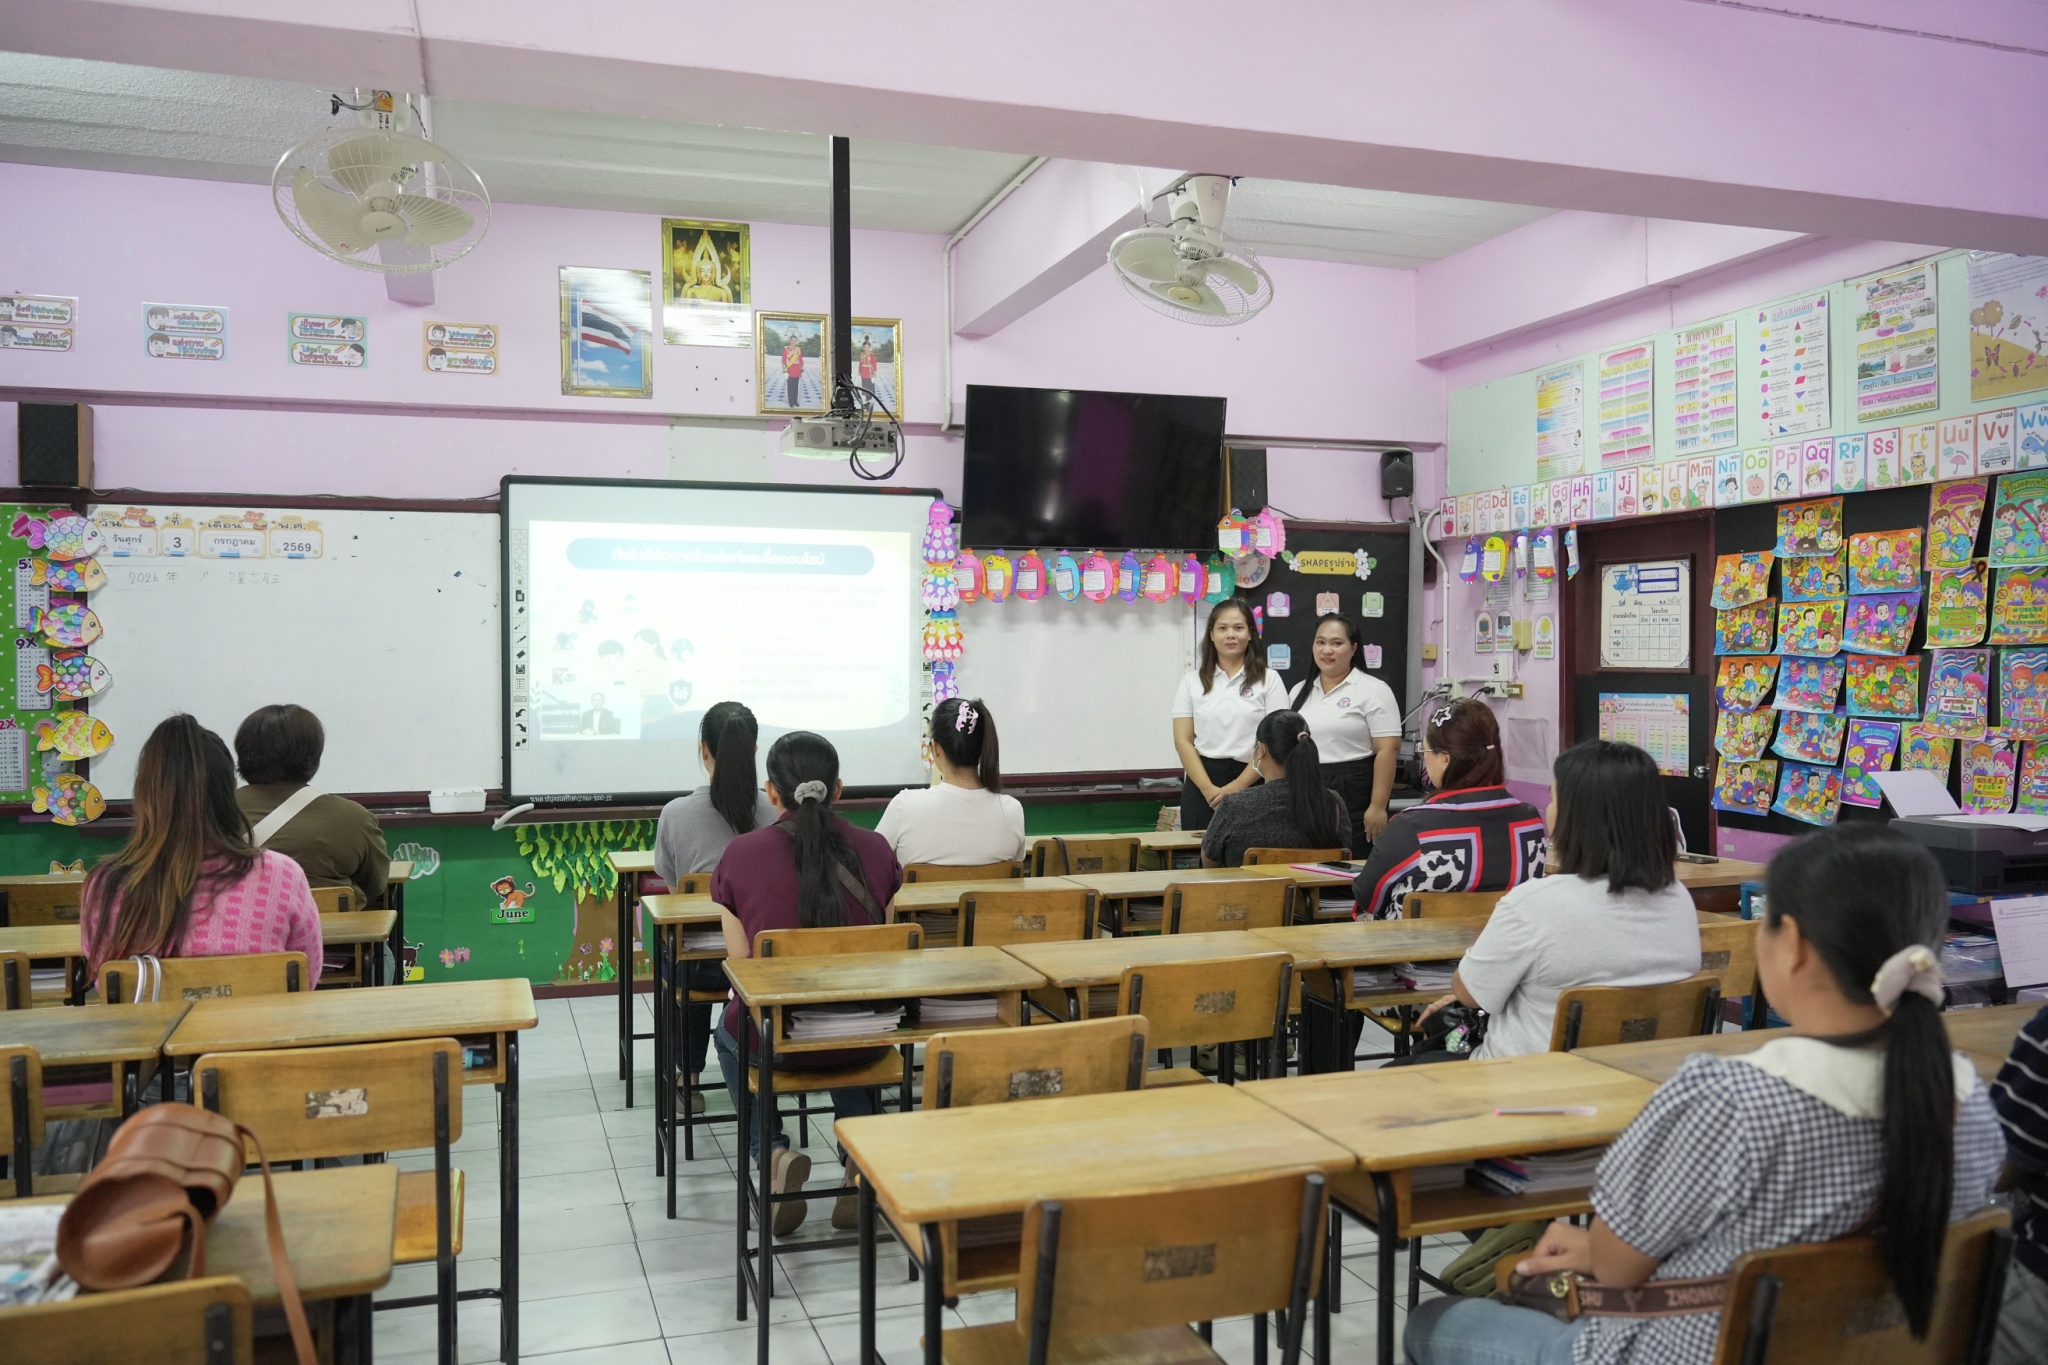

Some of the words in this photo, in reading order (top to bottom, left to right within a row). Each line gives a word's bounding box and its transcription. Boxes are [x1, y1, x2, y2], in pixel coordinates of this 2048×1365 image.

[1442, 502, 1454, 516] Aa
[1459, 501, 1472, 513] Bb
[1476, 498, 1491, 511] Cc
[1491, 494, 1508, 508] Dd
[1513, 491, 1527, 505] Ee
[1532, 487, 1546, 502] Ff
[1552, 484, 1568, 501] Gg
[1573, 481, 1590, 497] Hh
[1597, 477, 1608, 493] Ii
[1618, 475, 1632, 495] Jj
[1642, 471, 1658, 486] Kk
[1668, 467, 1680, 483] Ll
[1690, 463, 1712, 478] Mm
[1718, 459, 1737, 474] Nn
[1745, 454, 1768, 470] Oo
[1775, 449, 1797, 471] Pp
[1805, 445, 1830, 464] Qq
[1838, 442, 1861, 460] Rr
[1872, 437, 1894, 456] Ss
[1907, 433, 1928, 452] Tt
[1943, 425, 1969, 445] Uu
[1983, 421, 2009, 441] Vv
[99, 516, 122, 528] วัน
[171, 515, 180, 526] ที่
[207, 518, 242, 529] เดือน
[278, 521, 306, 530] พ.ศ.
[112, 534, 143, 545] วันศุกร์
[173, 536, 182, 549] 3
[213, 537, 256, 547] กรกฎาคม
[283, 542, 312, 552] 2569
[15, 637, 38, 649] 9X
[497, 909, 529, 919] June
